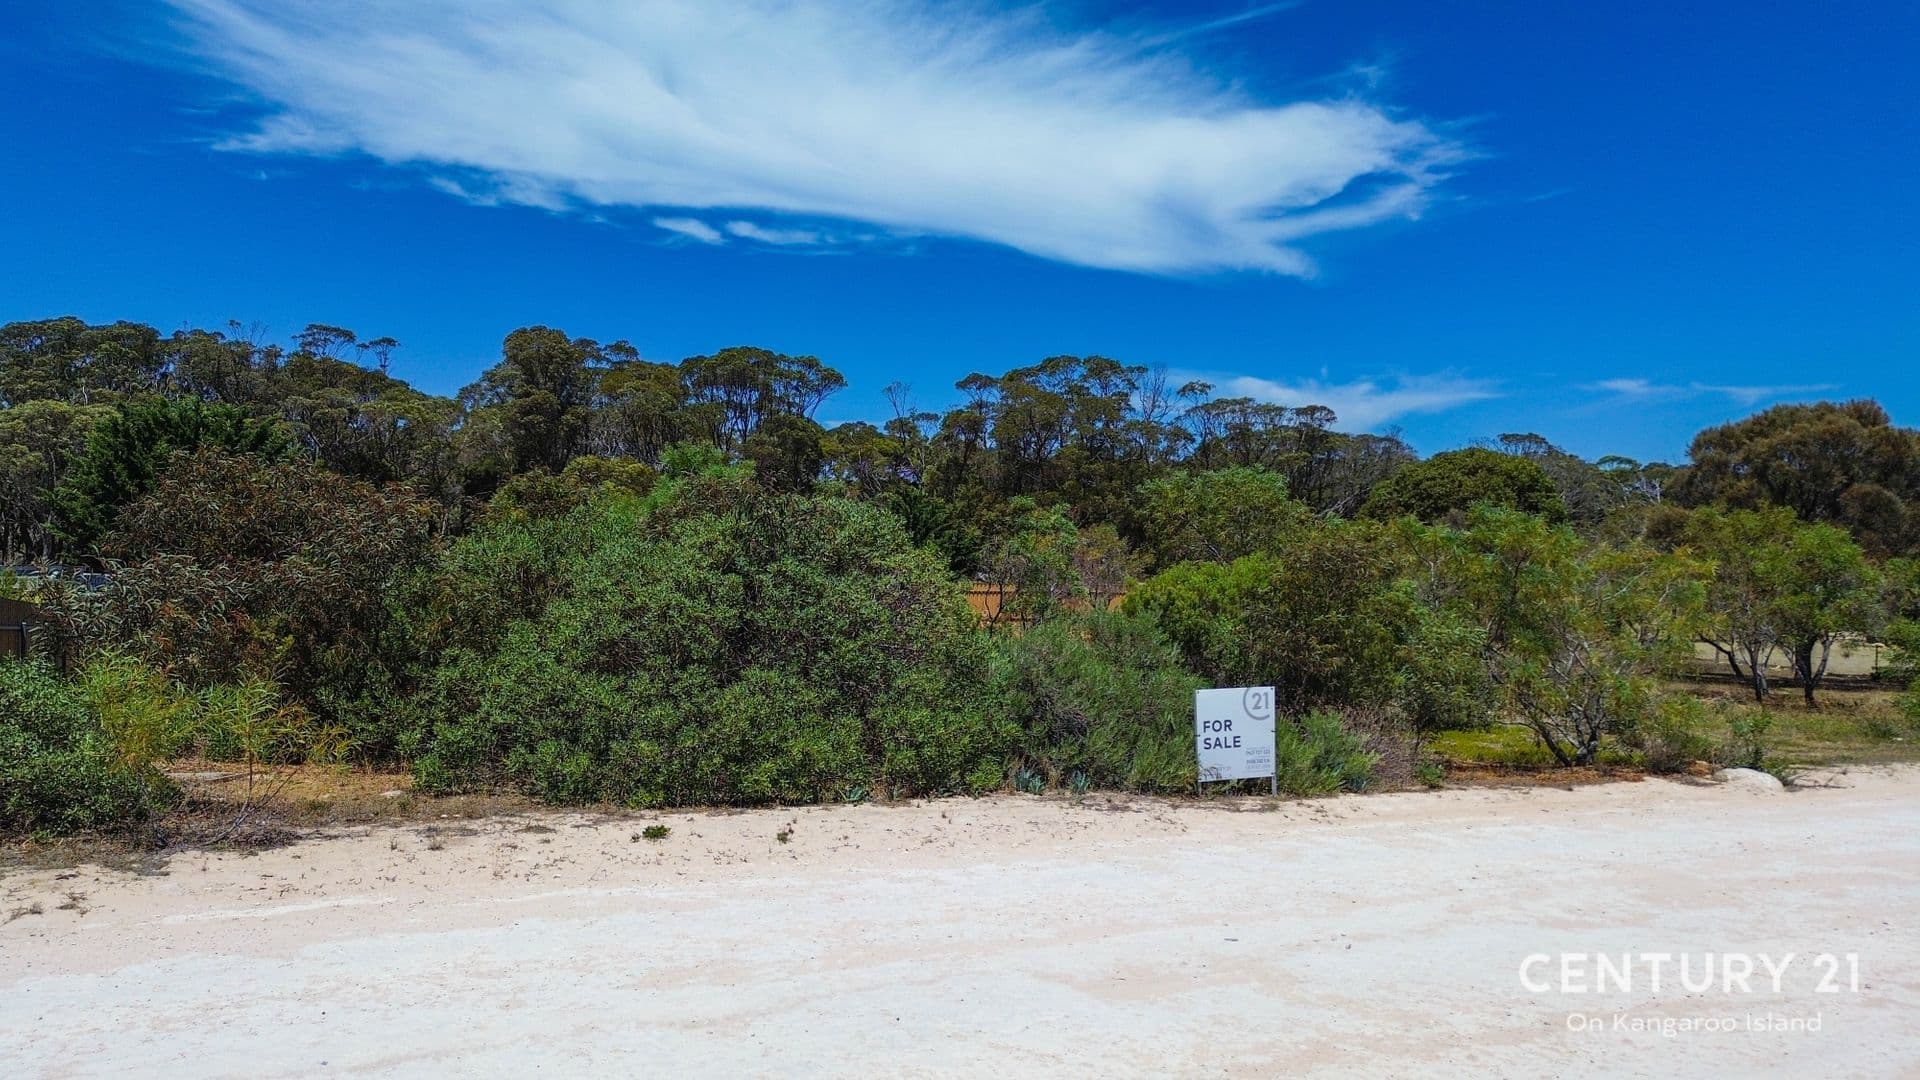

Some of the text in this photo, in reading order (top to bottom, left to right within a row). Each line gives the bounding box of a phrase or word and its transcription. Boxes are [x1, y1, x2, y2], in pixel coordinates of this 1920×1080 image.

[1252, 692, 1269, 710] 21
[1203, 720, 1233, 733] FOR
[1203, 736, 1242, 750] SALE
